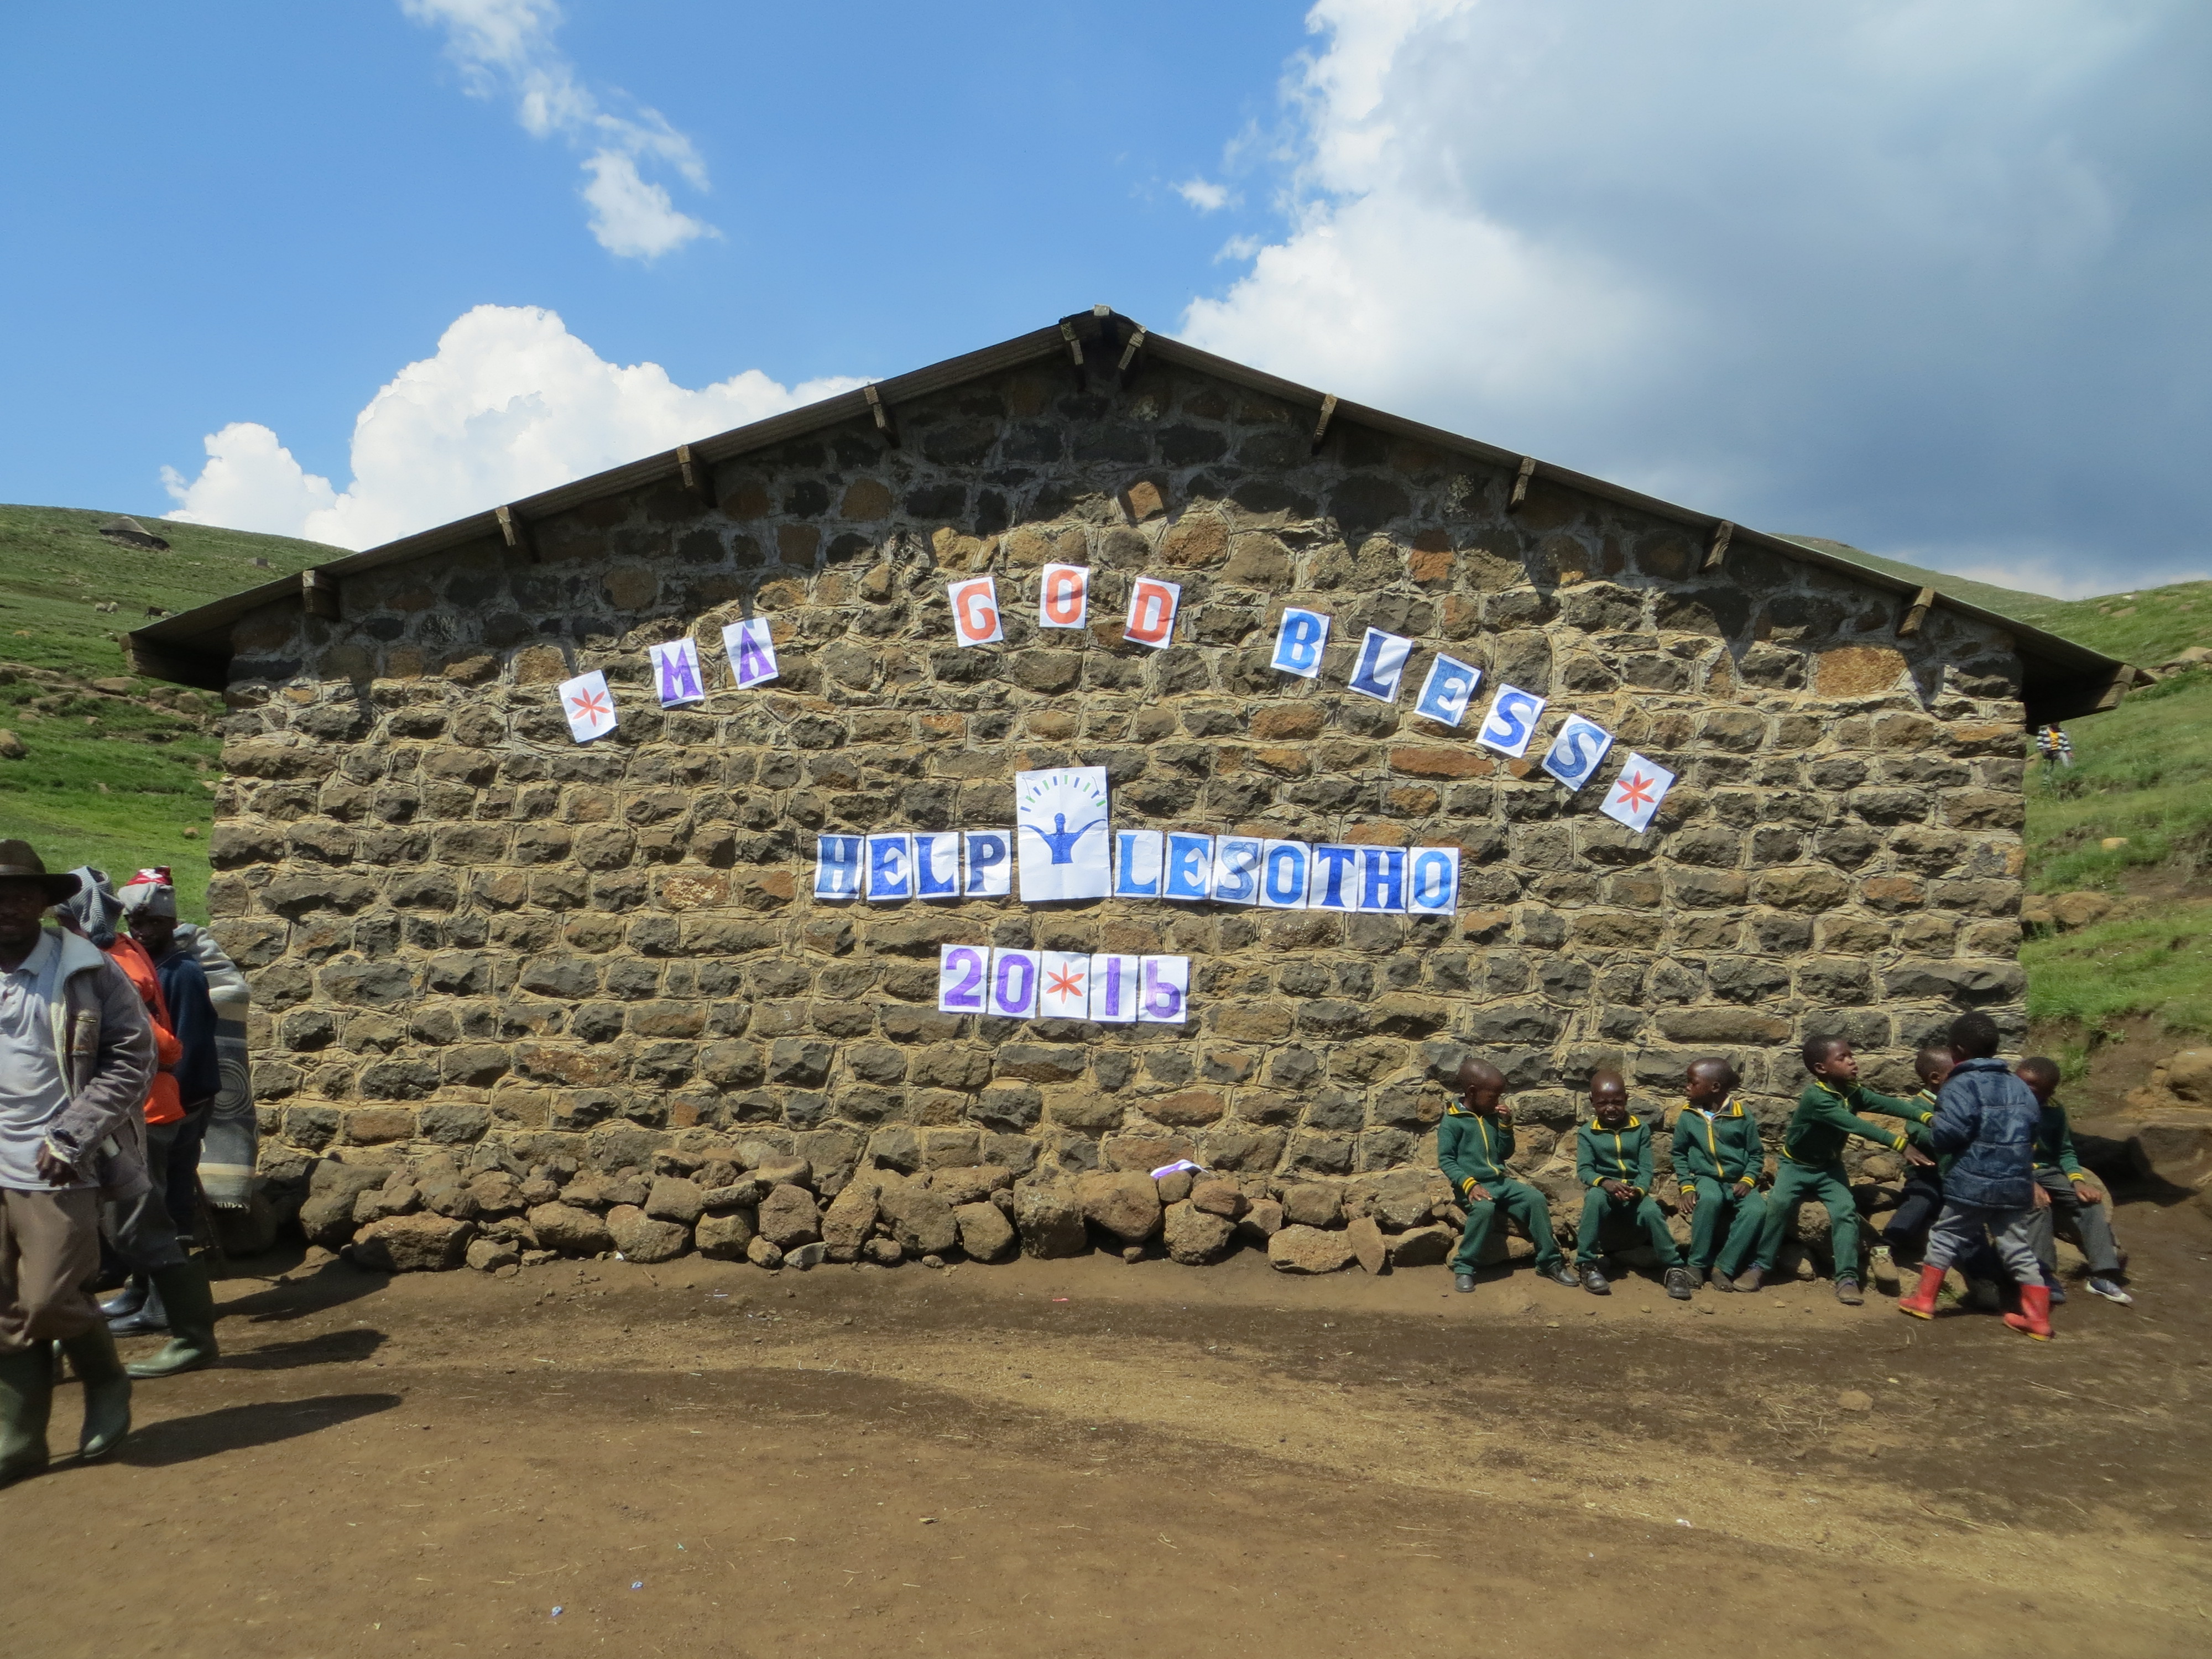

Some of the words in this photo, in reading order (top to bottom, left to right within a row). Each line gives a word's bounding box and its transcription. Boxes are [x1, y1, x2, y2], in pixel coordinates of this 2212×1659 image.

[956, 568, 1173, 643] GOD
[1274, 609, 1606, 779] BLESS
[816, 834, 1006, 896] HELP
[1115, 834, 1451, 909] LESOTHO
